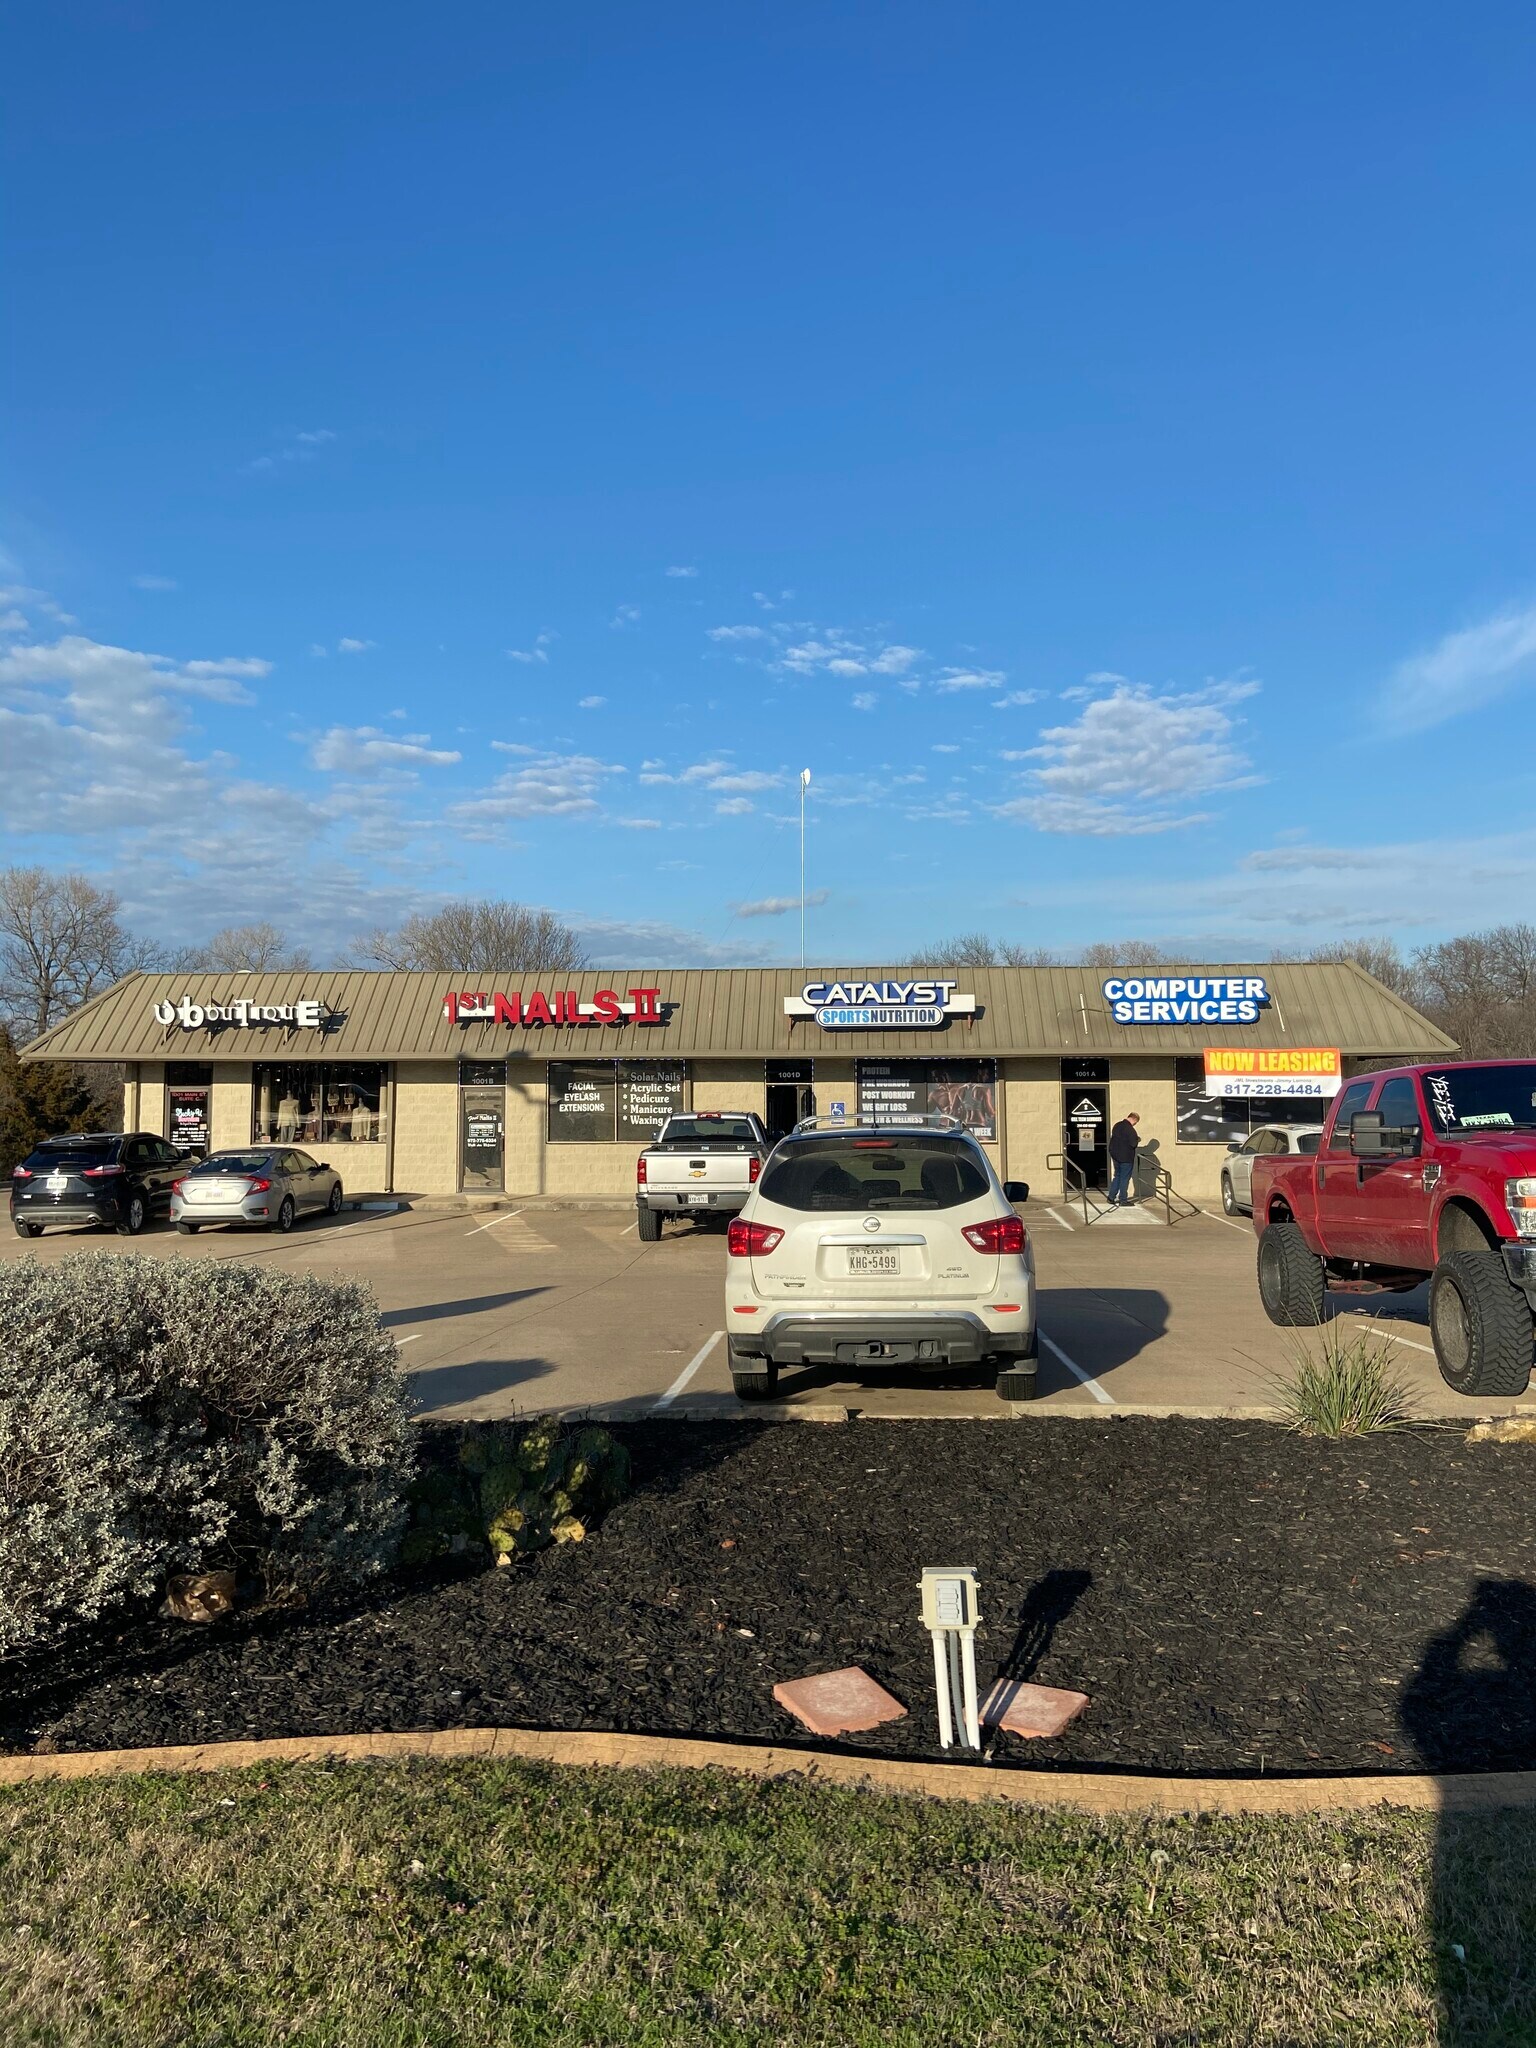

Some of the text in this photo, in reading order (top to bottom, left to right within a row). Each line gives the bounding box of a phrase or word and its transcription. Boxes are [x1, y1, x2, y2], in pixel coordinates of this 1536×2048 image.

[802, 981, 956, 1005] CATALYST
[1104, 979, 1266, 1000] COMPUTER
[493, 990, 622, 1024] NAILS
[628, 988, 661, 1022] II
[1114, 1001, 1257, 1021] SERVICES
[1209, 1051, 1336, 1072] NOW LEASING
[862, 1066, 891, 1075] PROTEIN
[630, 1071, 681, 1081] Solar Nails
[567, 1082, 596, 1090] FACIAL
[876, 1079, 911, 1087] WORKOUT
[630, 1083, 681, 1094] Acrylic Set
[1224, 1084, 1322, 1095] 817-228-4484
[564, 1093, 600, 1101] EYELASH
[630, 1094, 670, 1103] Pedicure
[862, 1091, 916, 1100] POST WORKOUT
[559, 1103, 605, 1112] EXTENSIONS
[630, 1104, 673, 1114] Manicure
[890, 1103, 908, 1111] LOSS
[630, 1115, 664, 1126] Waxing
[974, 1127, 992, 1137] WEEK
